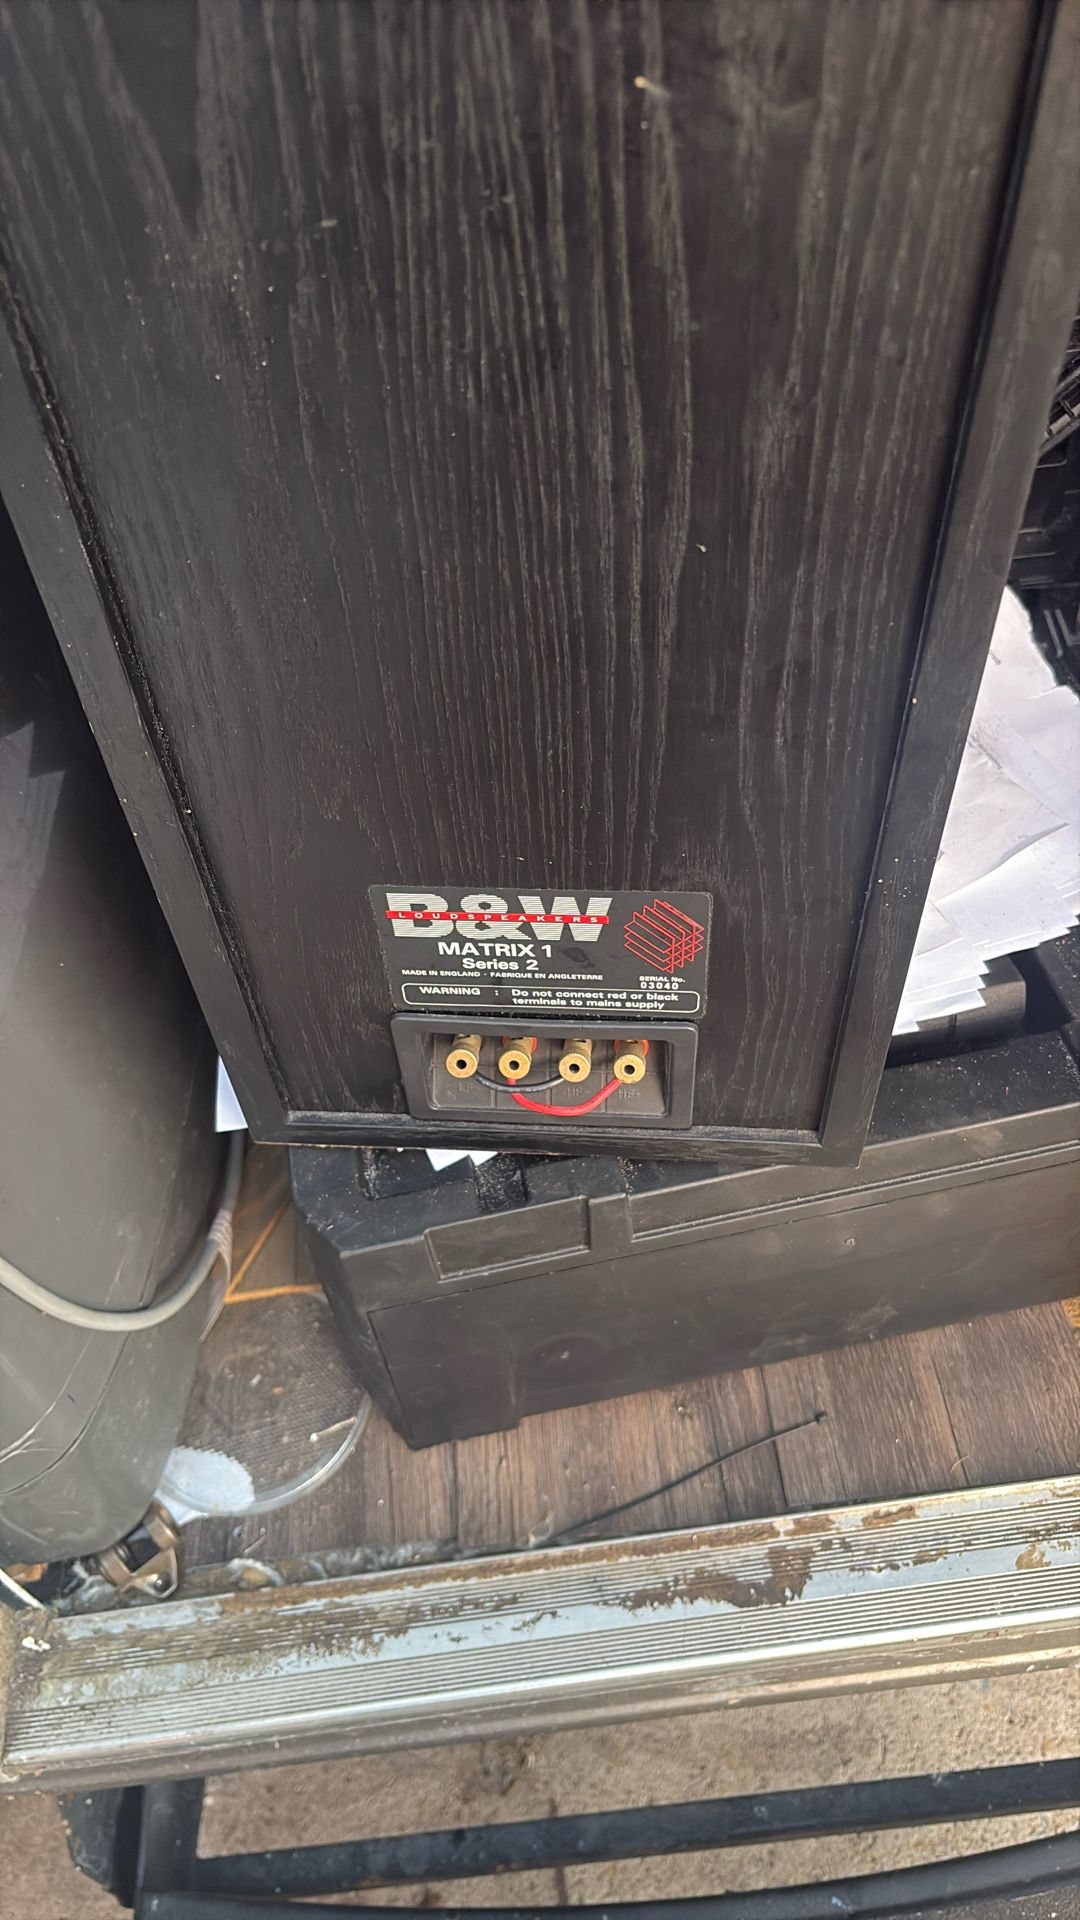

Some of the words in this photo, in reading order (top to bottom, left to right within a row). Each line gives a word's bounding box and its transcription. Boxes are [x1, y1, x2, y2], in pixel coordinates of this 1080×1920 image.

[398, 912, 598, 923] LOUDSPEAKERS
[438, 942, 536, 958] MATRIX
[541, 944, 552, 958] 1
[462, 958, 519, 970] Series
[526, 959, 539, 971] 2
[548, 973, 604, 981] ANGLETERRE
[640, 982, 679, 990] 03040
[419, 986, 481, 996] WARNING
[512, 988, 529, 997] Do
[532, 990, 552, 998] not
[556, 991, 604, 999] connect
[607, 992, 627, 1000] red
[646, 992, 679, 1001] black
[512, 997, 567, 1006] terminals
[570, 998, 582, 1006] to
[586, 1000, 622, 1008] mains
[625, 1000, 665, 1010] supply
